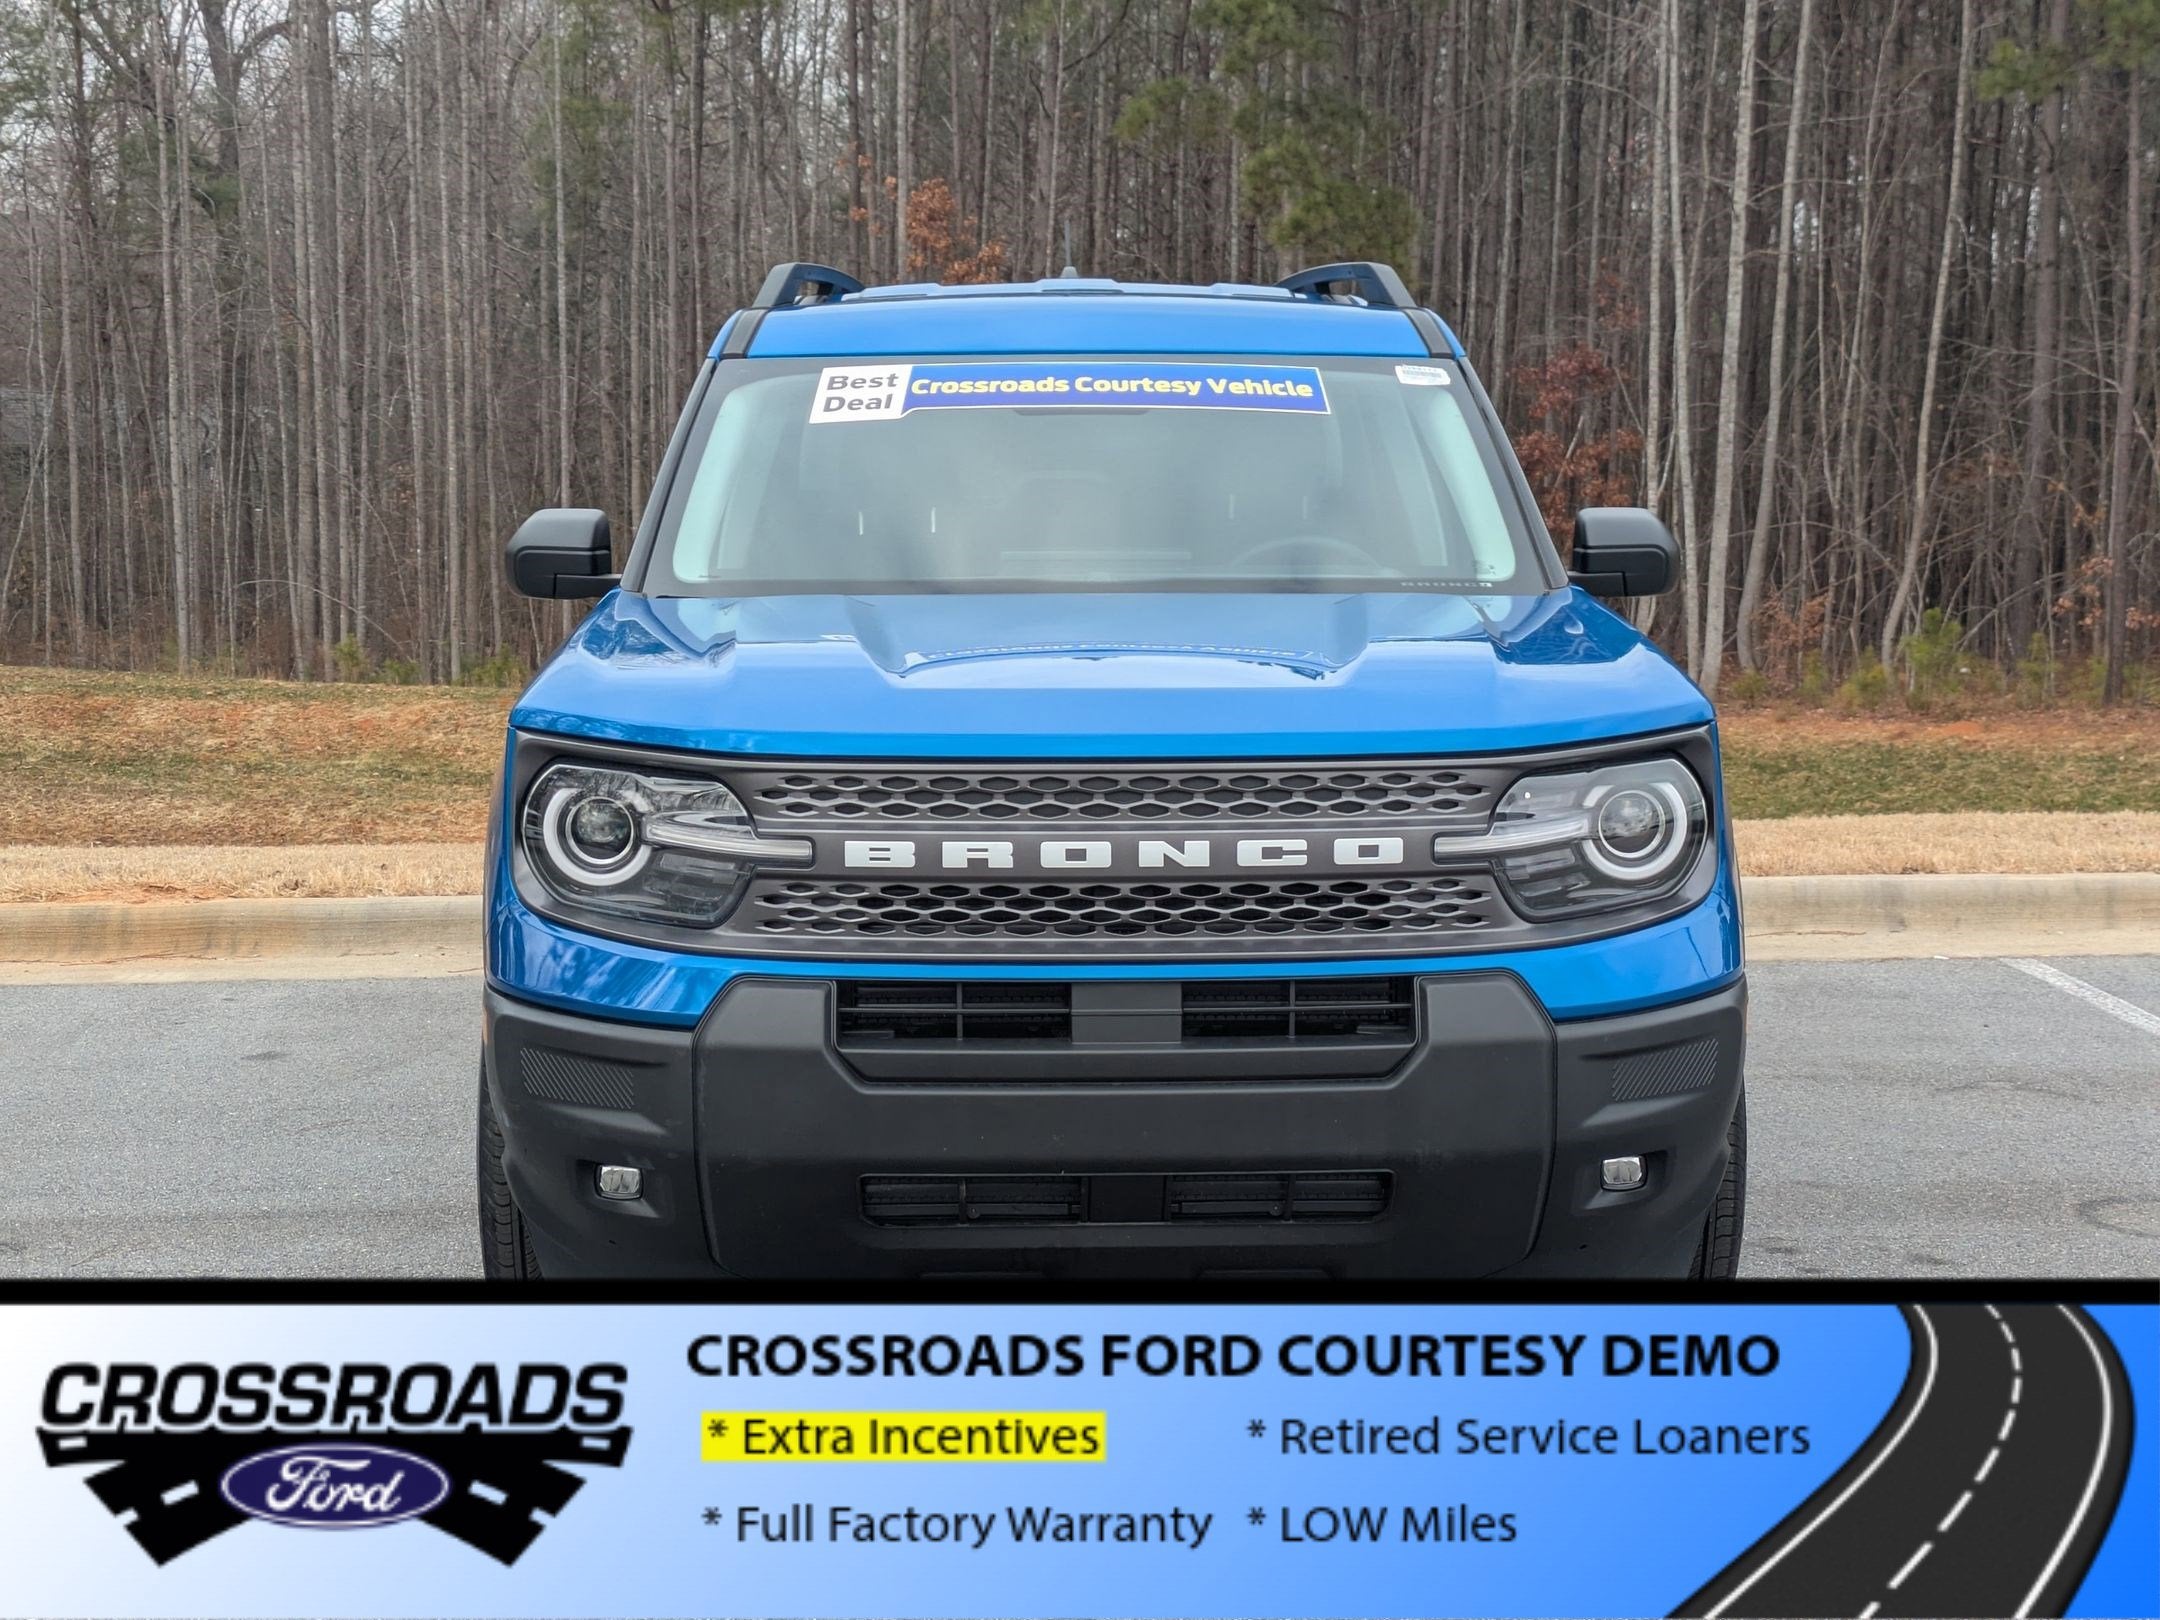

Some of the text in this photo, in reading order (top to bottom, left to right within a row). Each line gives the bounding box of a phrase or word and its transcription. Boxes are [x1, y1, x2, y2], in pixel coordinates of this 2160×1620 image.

[827, 373, 899, 391] Best
[911, 376, 1314, 397] Crossroads Courtesy Vehicle
[823, 394, 893, 413] Deal
[844, 837, 1404, 869] BRONCO
